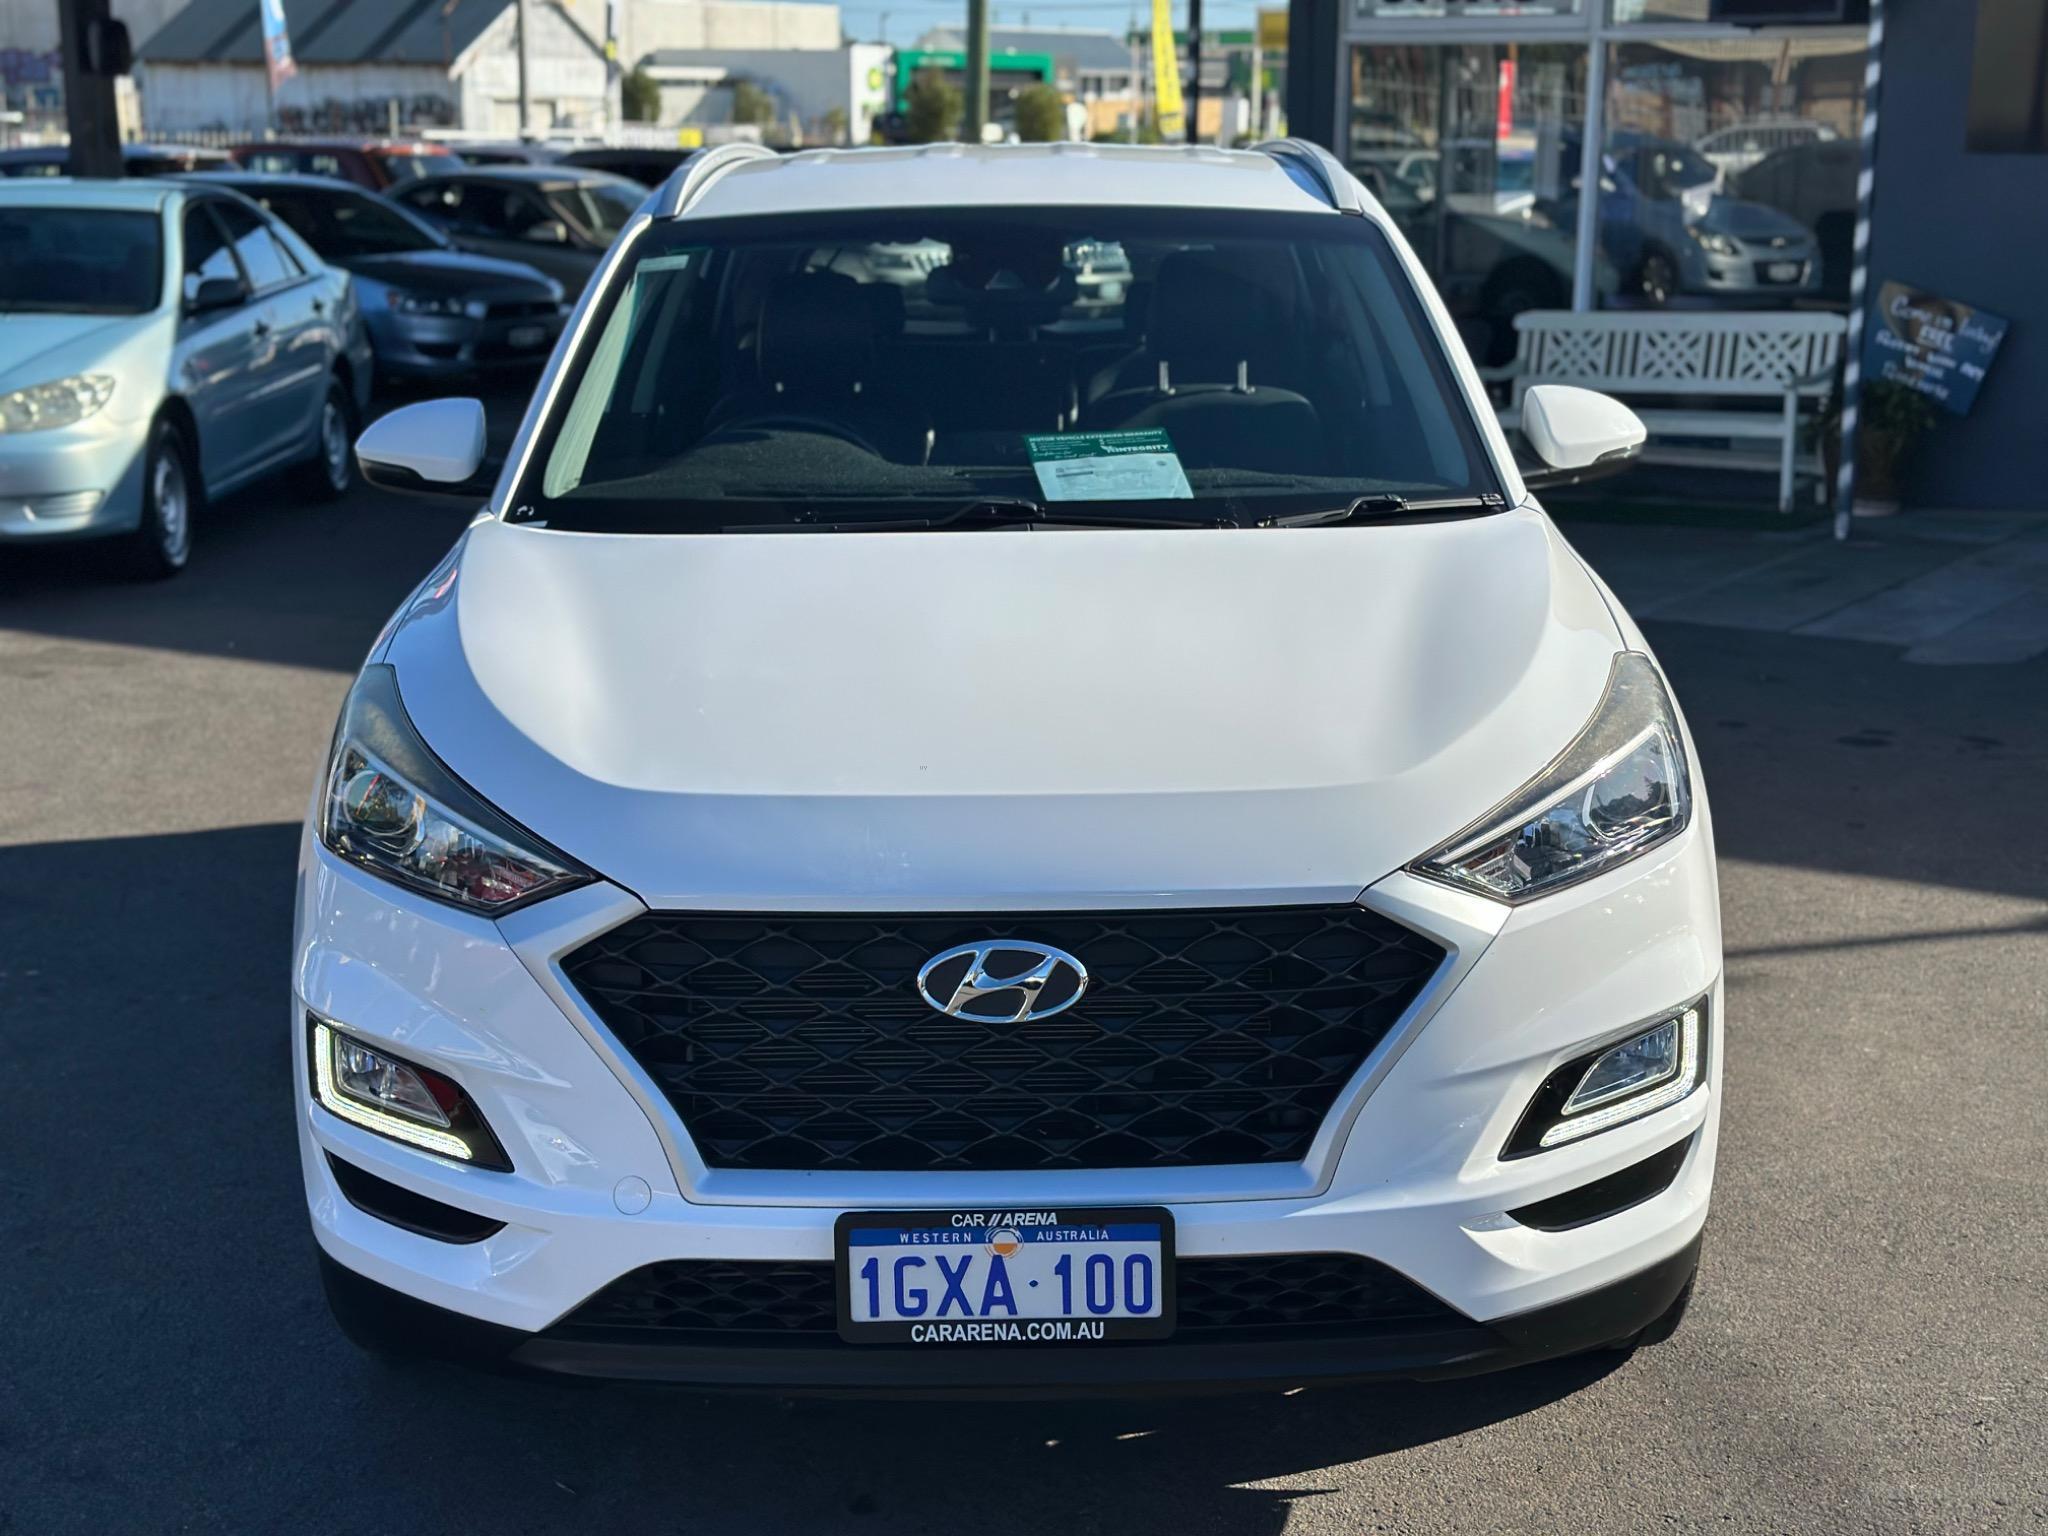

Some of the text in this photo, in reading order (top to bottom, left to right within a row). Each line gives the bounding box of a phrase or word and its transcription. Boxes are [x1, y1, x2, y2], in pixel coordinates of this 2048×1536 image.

[952, 1212, 1058, 1227] CAR ARENA
[900, 1230, 1110, 1244] WESTERN AUSTRALIA
[911, 1322, 1105, 1342] CARARENA.COM.AU
